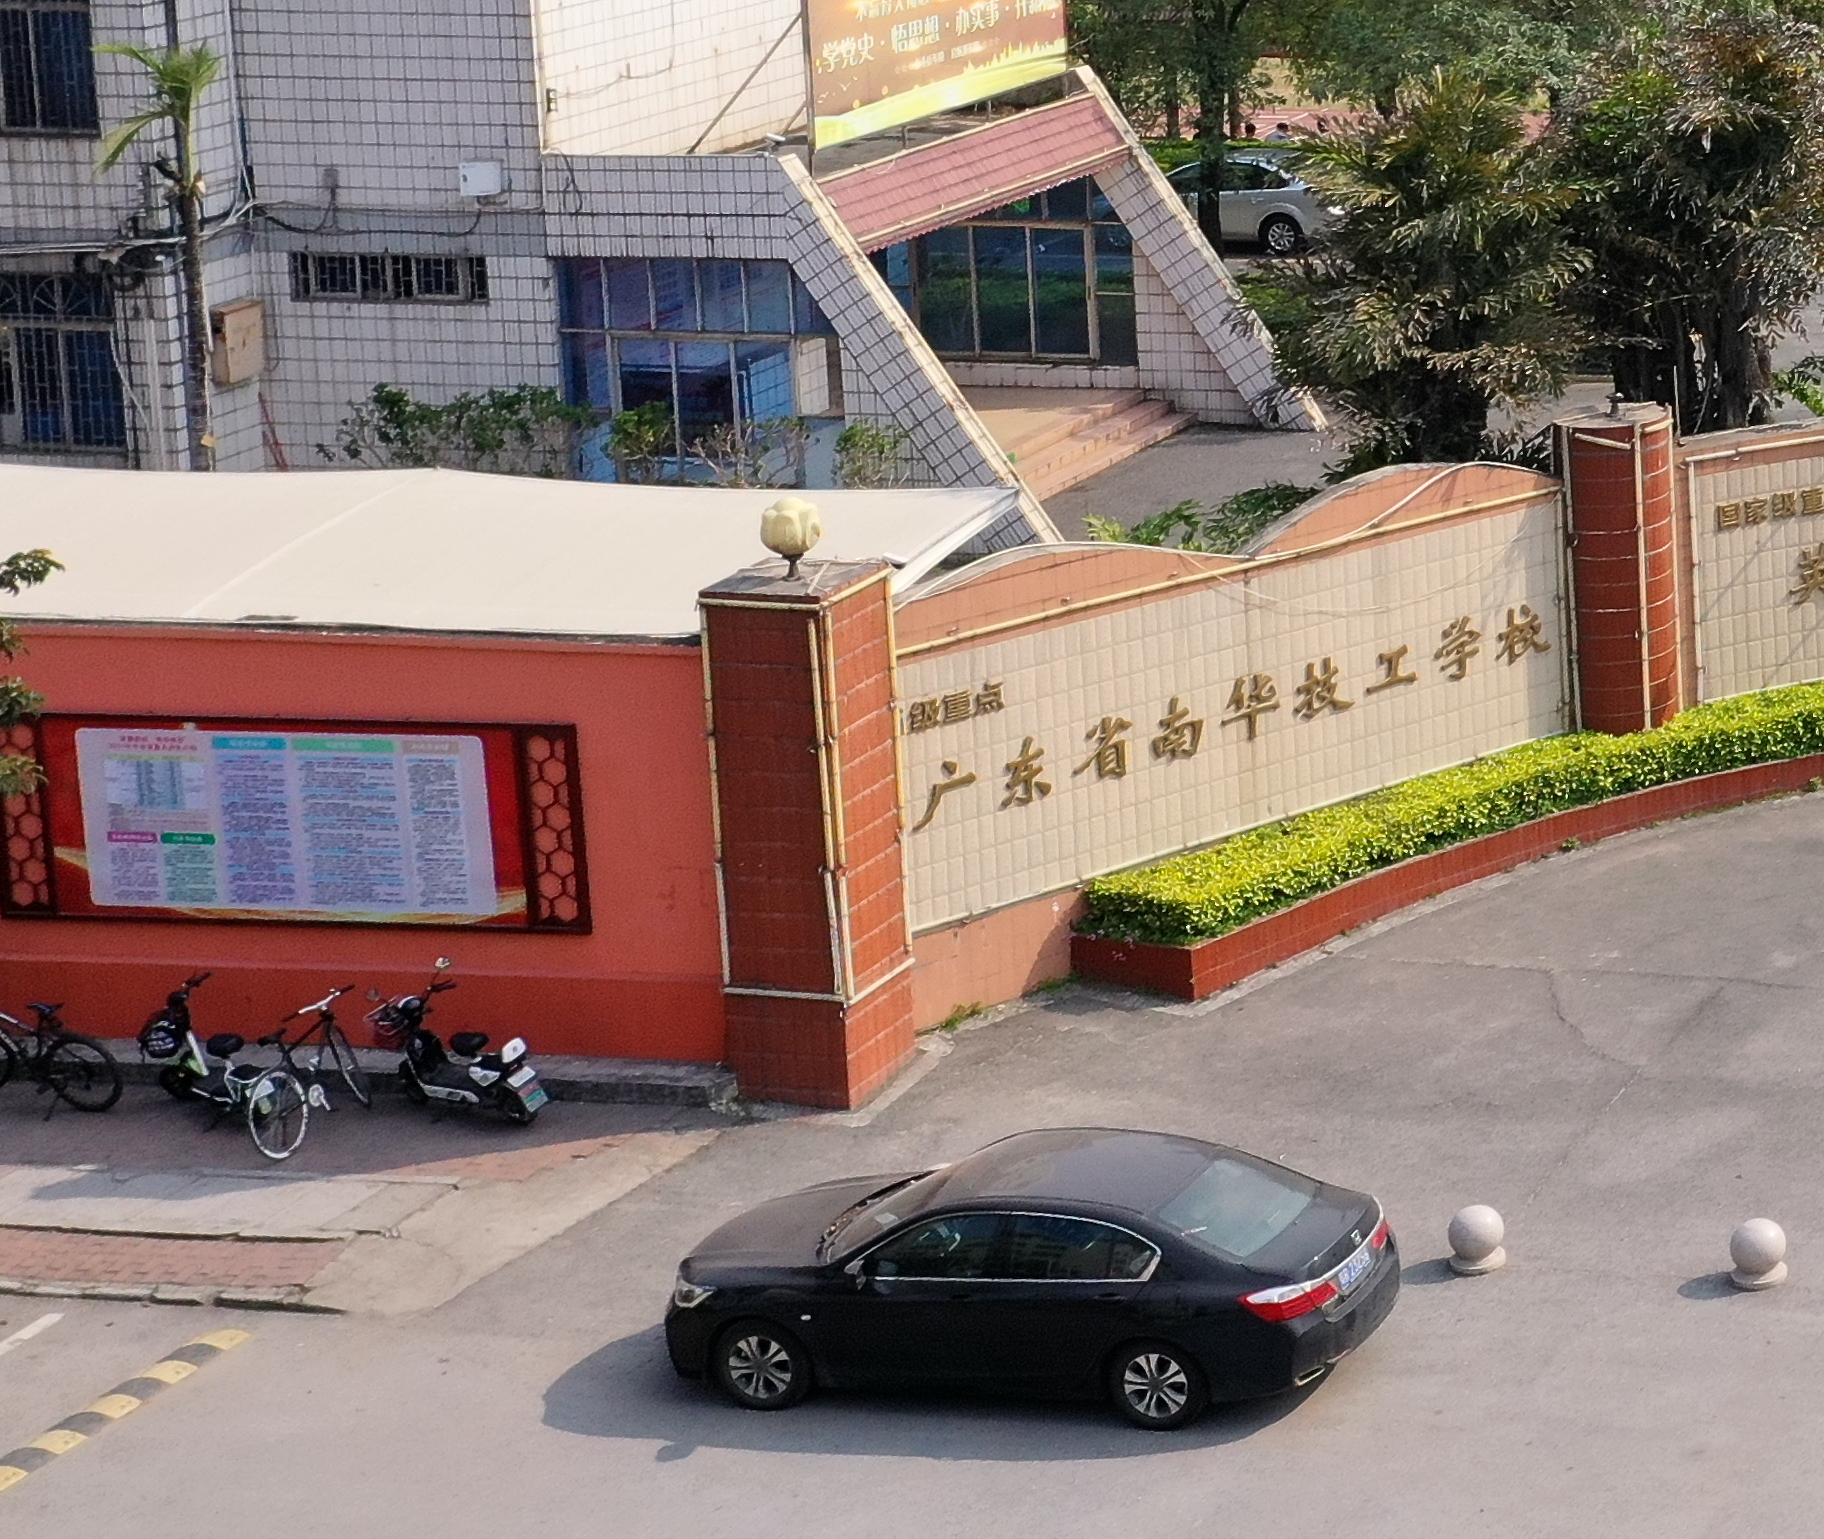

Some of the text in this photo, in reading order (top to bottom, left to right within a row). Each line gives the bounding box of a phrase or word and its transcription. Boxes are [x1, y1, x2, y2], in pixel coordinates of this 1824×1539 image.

[912, 604, 1552, 832] 广东省南华技工学校
